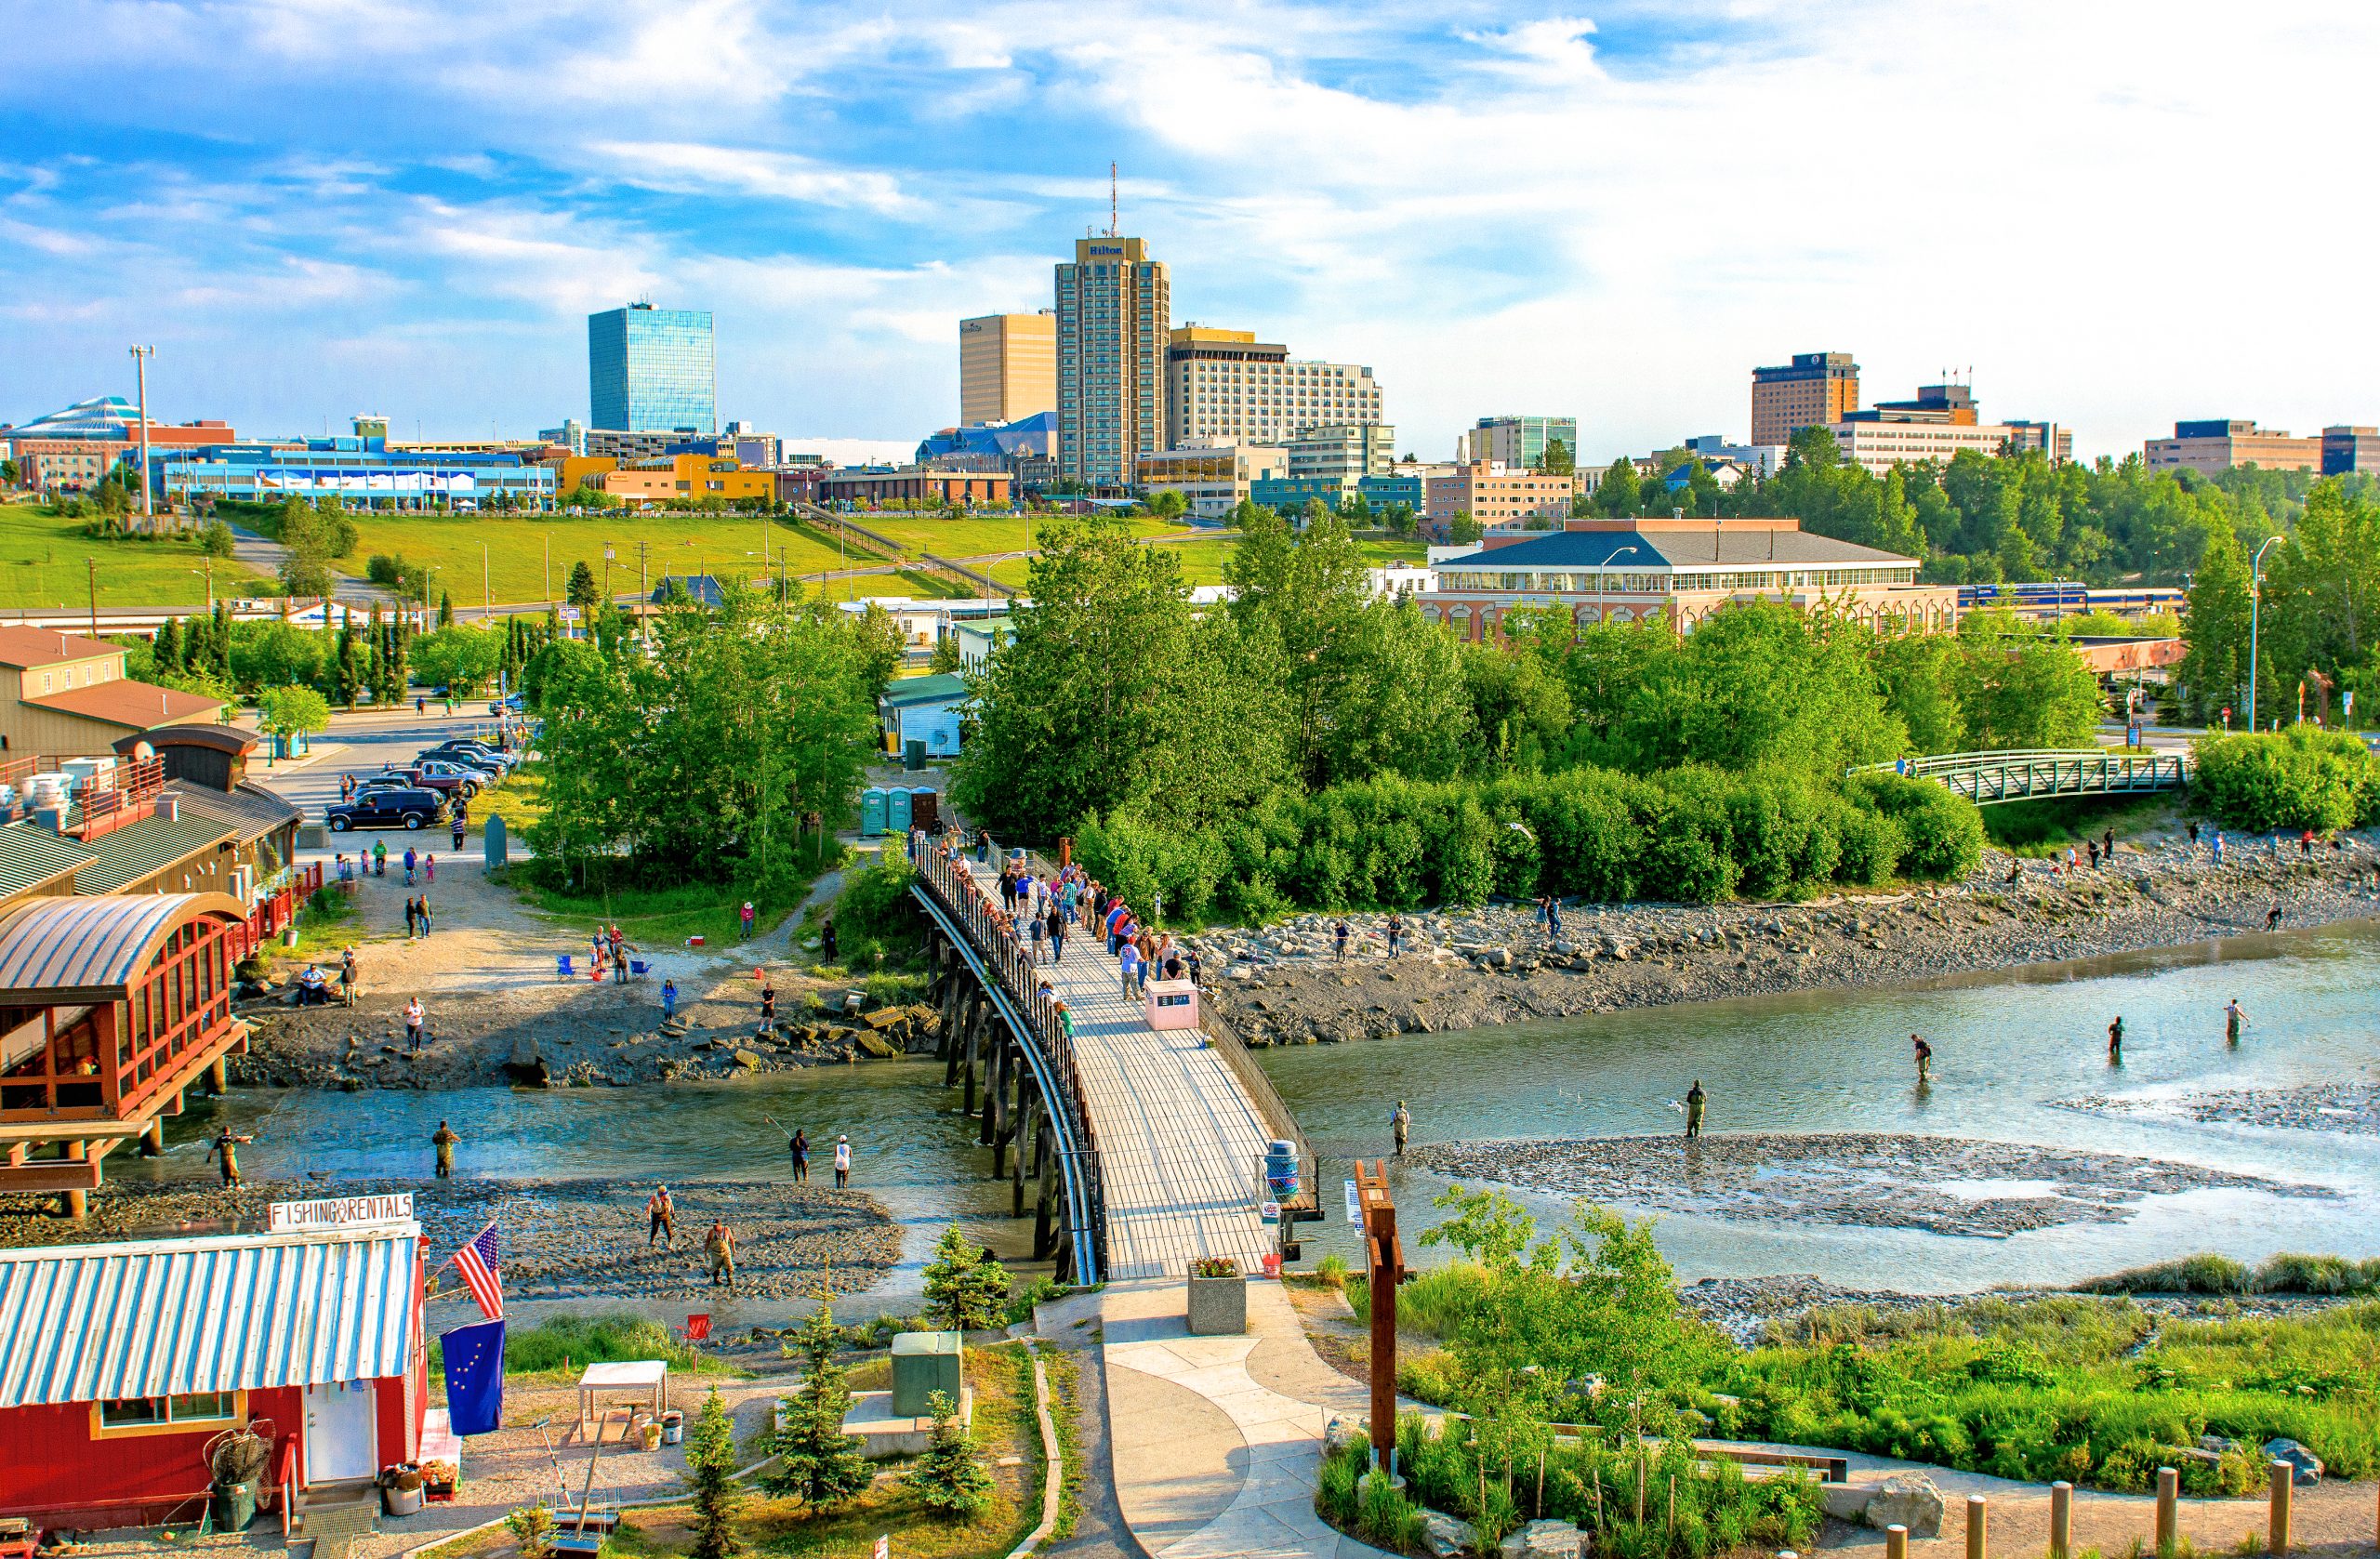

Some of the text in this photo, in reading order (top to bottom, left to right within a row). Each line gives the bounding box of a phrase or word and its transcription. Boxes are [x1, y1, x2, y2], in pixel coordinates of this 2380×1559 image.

[1090, 245, 1122, 255] Hilton
[272, 1196, 412, 1225] FISHING RENTALS
